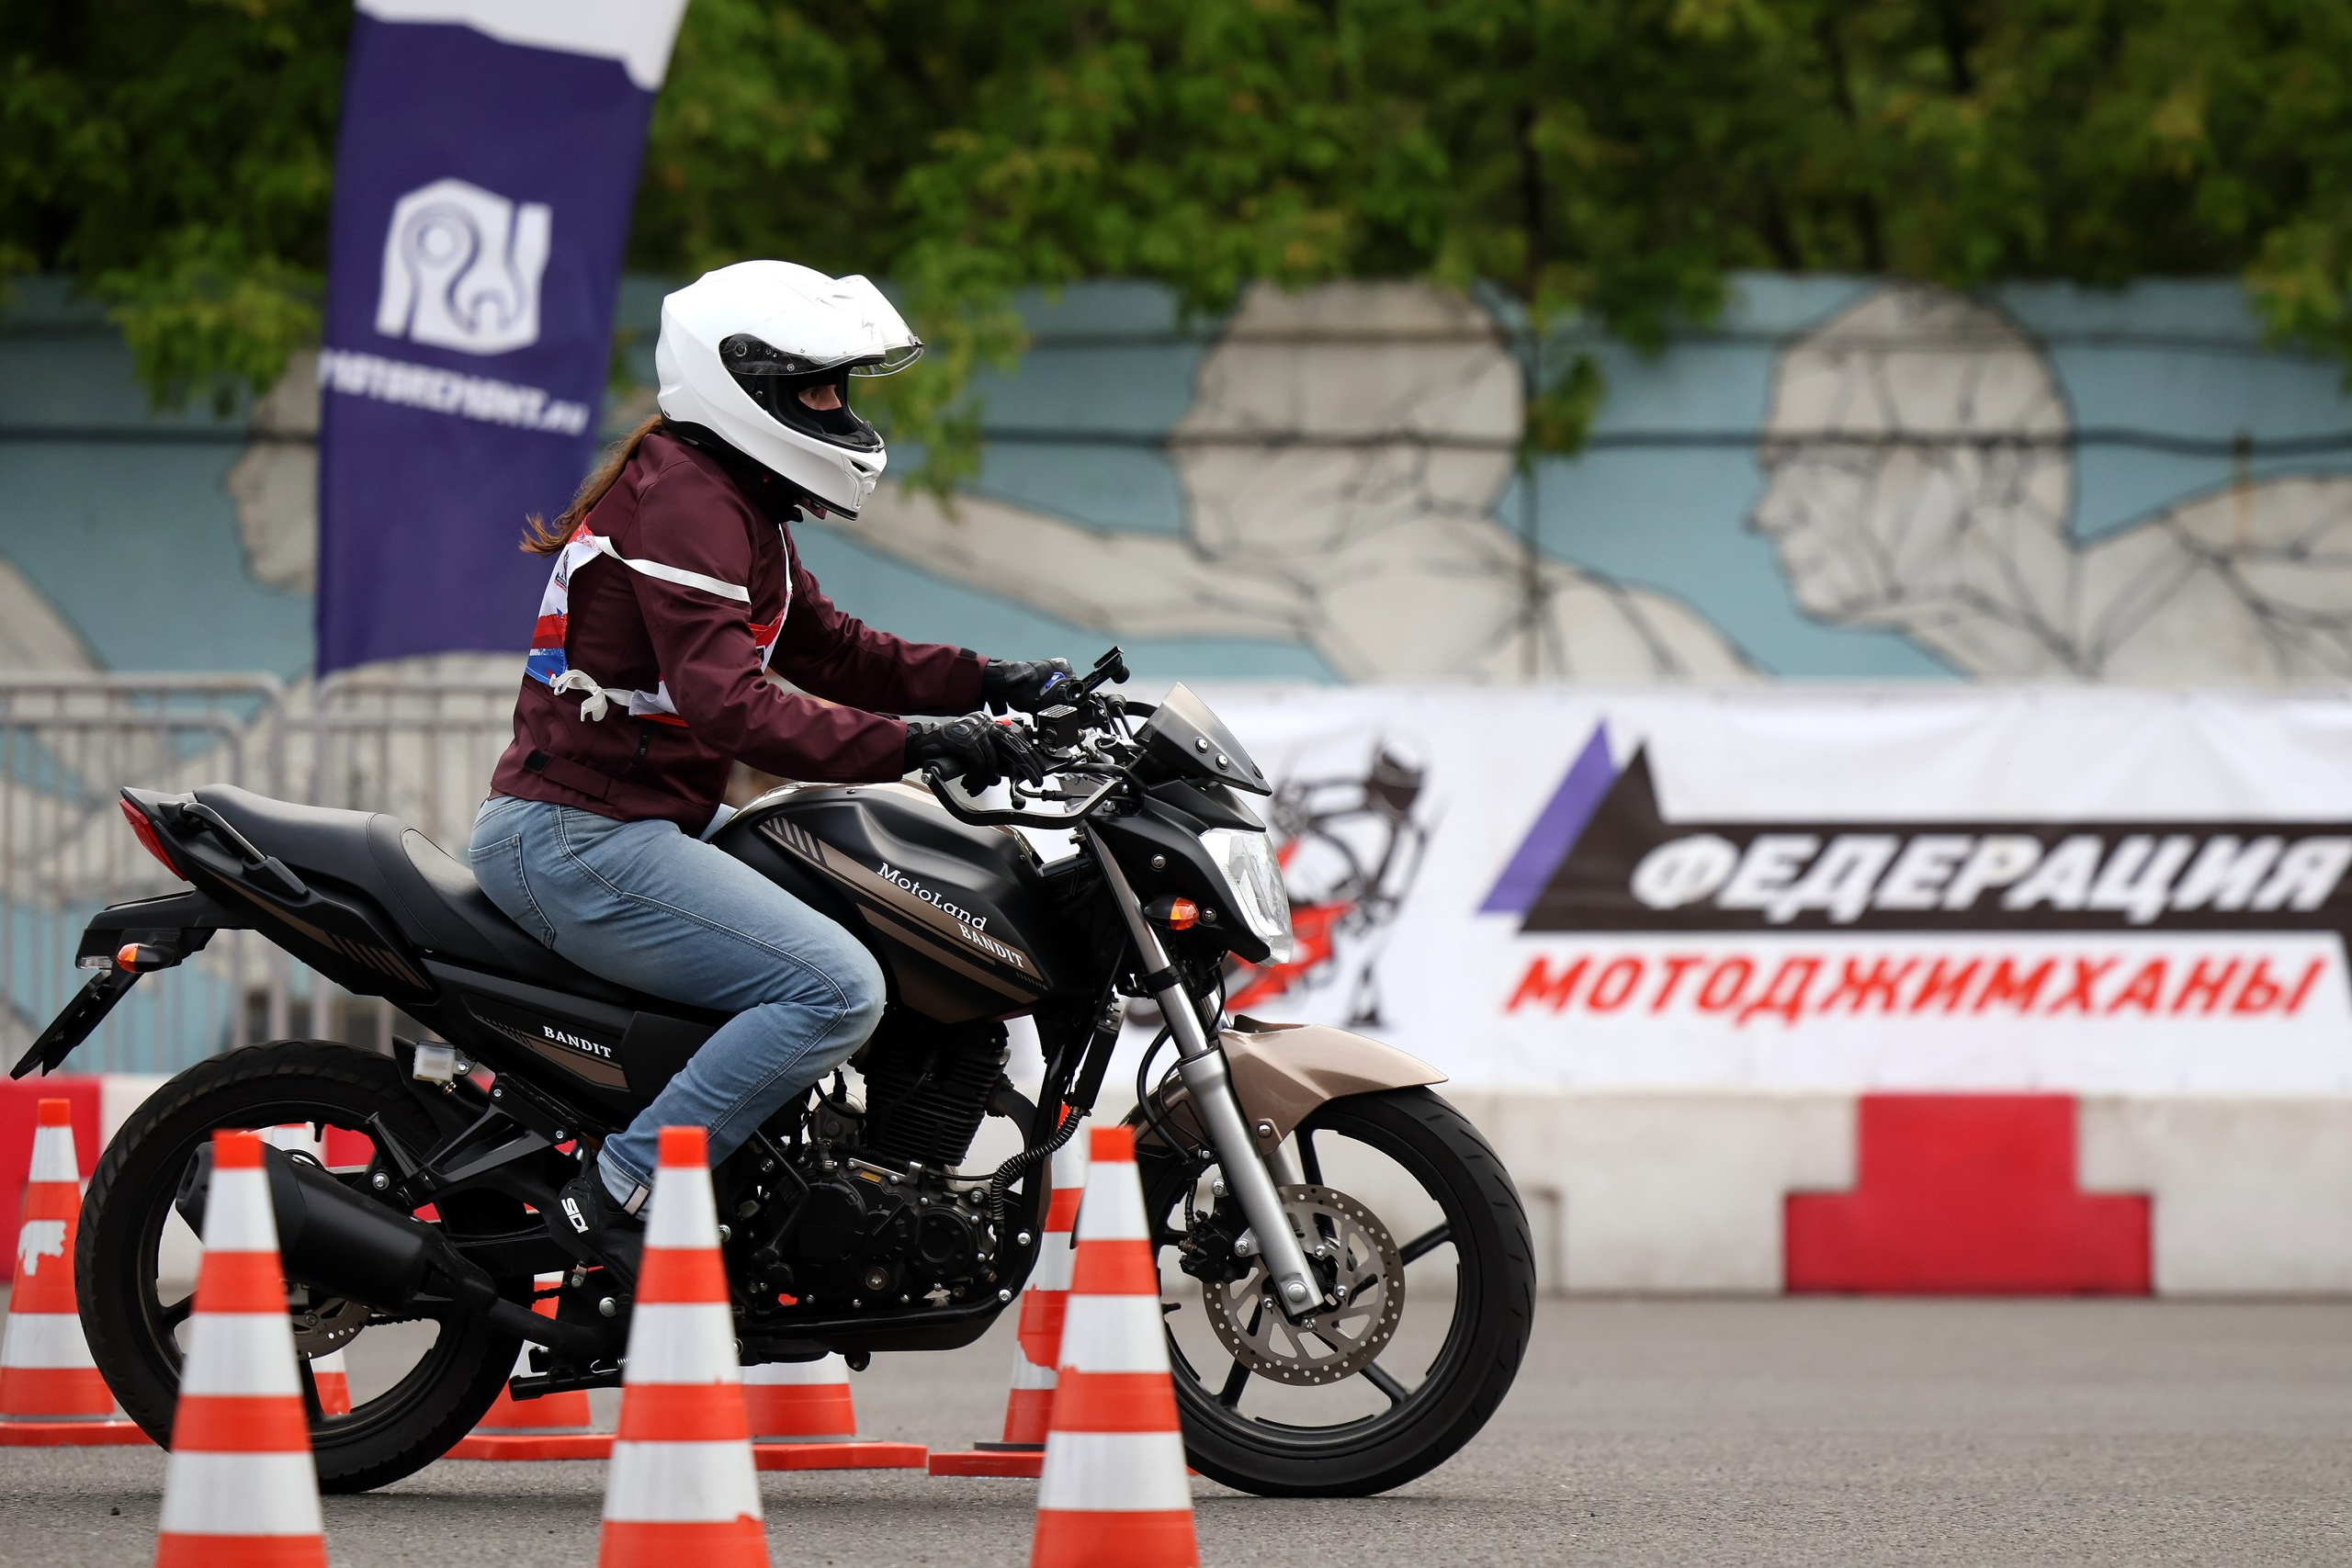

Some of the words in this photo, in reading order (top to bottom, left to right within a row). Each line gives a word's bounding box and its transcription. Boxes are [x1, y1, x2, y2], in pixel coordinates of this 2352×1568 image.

[877, 863, 987, 931] MotoLand
[1631, 834, 2352, 923] ФЕДЕРАЦИЯ
[957, 923, 1024, 967] BANDIT
[1503, 955, 2327, 1027] МОТОДЖИМХАНЫ
[543, 1026, 612, 1057] BANDIT
